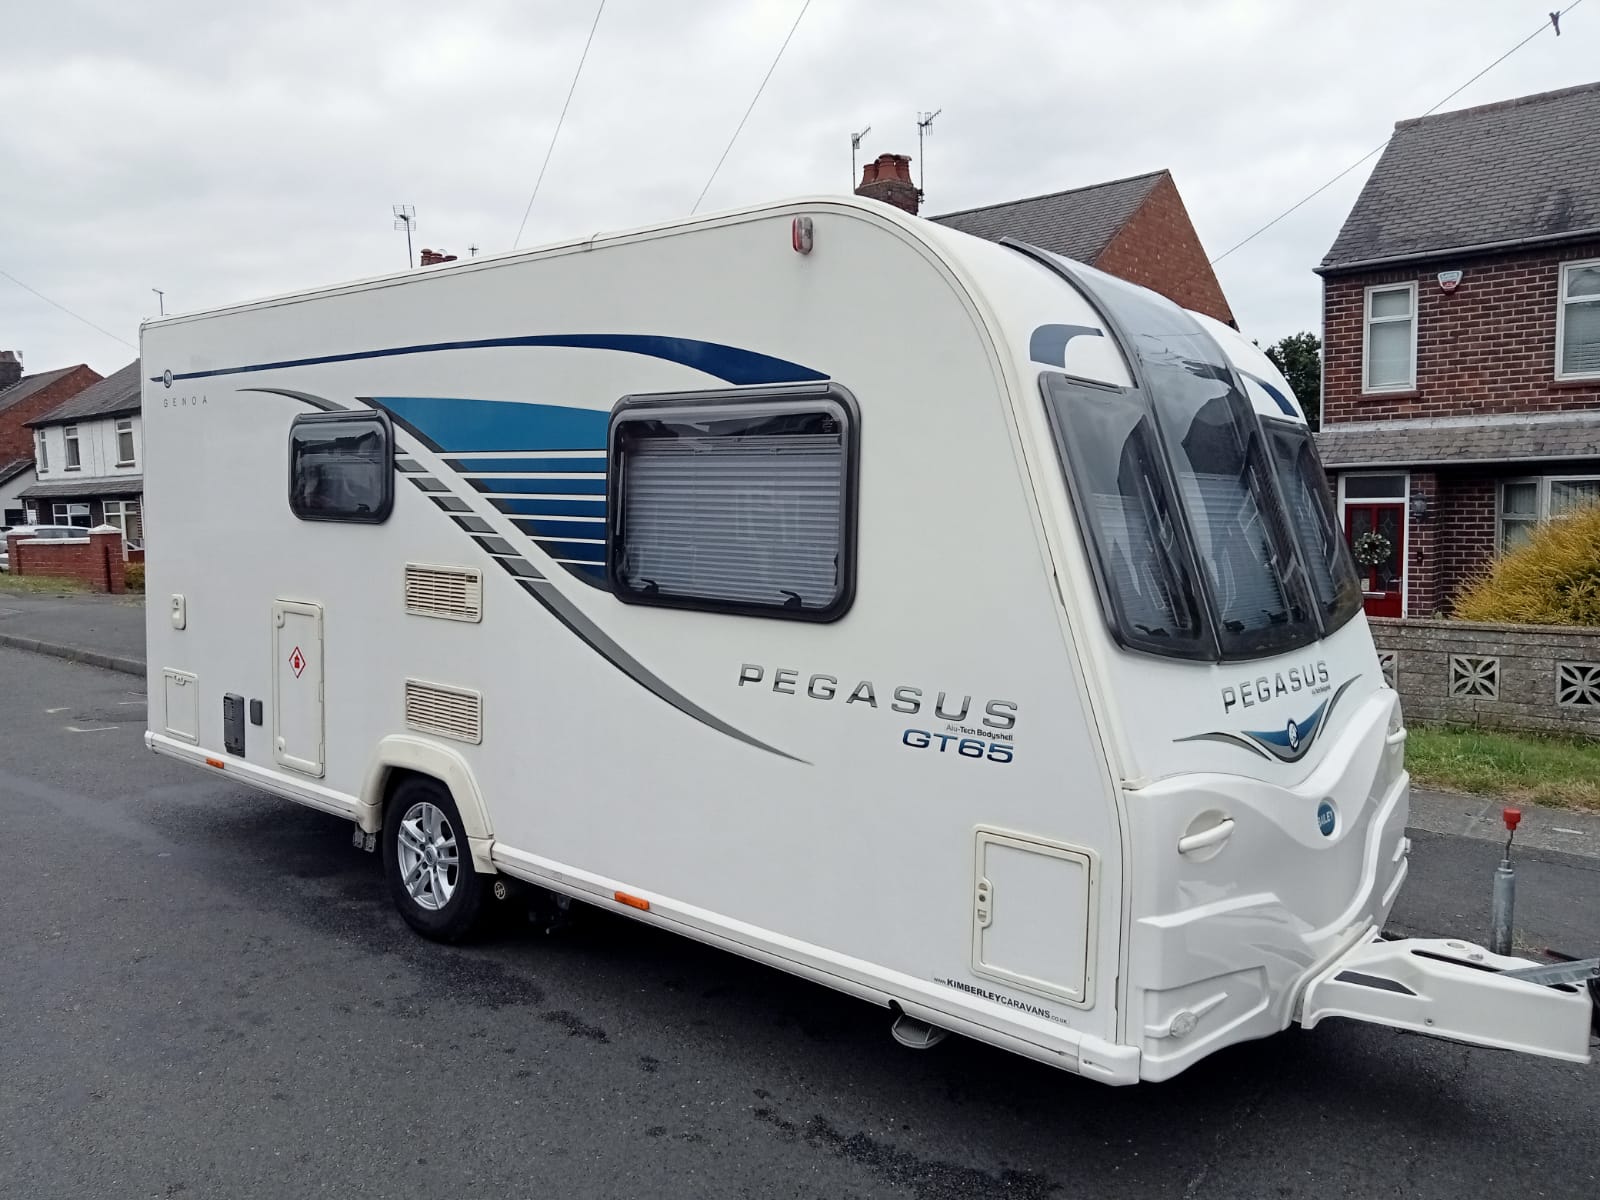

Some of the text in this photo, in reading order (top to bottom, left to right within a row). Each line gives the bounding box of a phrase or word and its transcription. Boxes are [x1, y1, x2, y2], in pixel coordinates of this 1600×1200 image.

[163, 395, 208, 408] GENOA
[738, 663, 1018, 730] PEGASUS
[1221, 660, 1329, 714] PEGASUS
[902, 728, 1014, 764] GT65
[945, 723, 1014, 741] Alu-Tech Bodyshell
